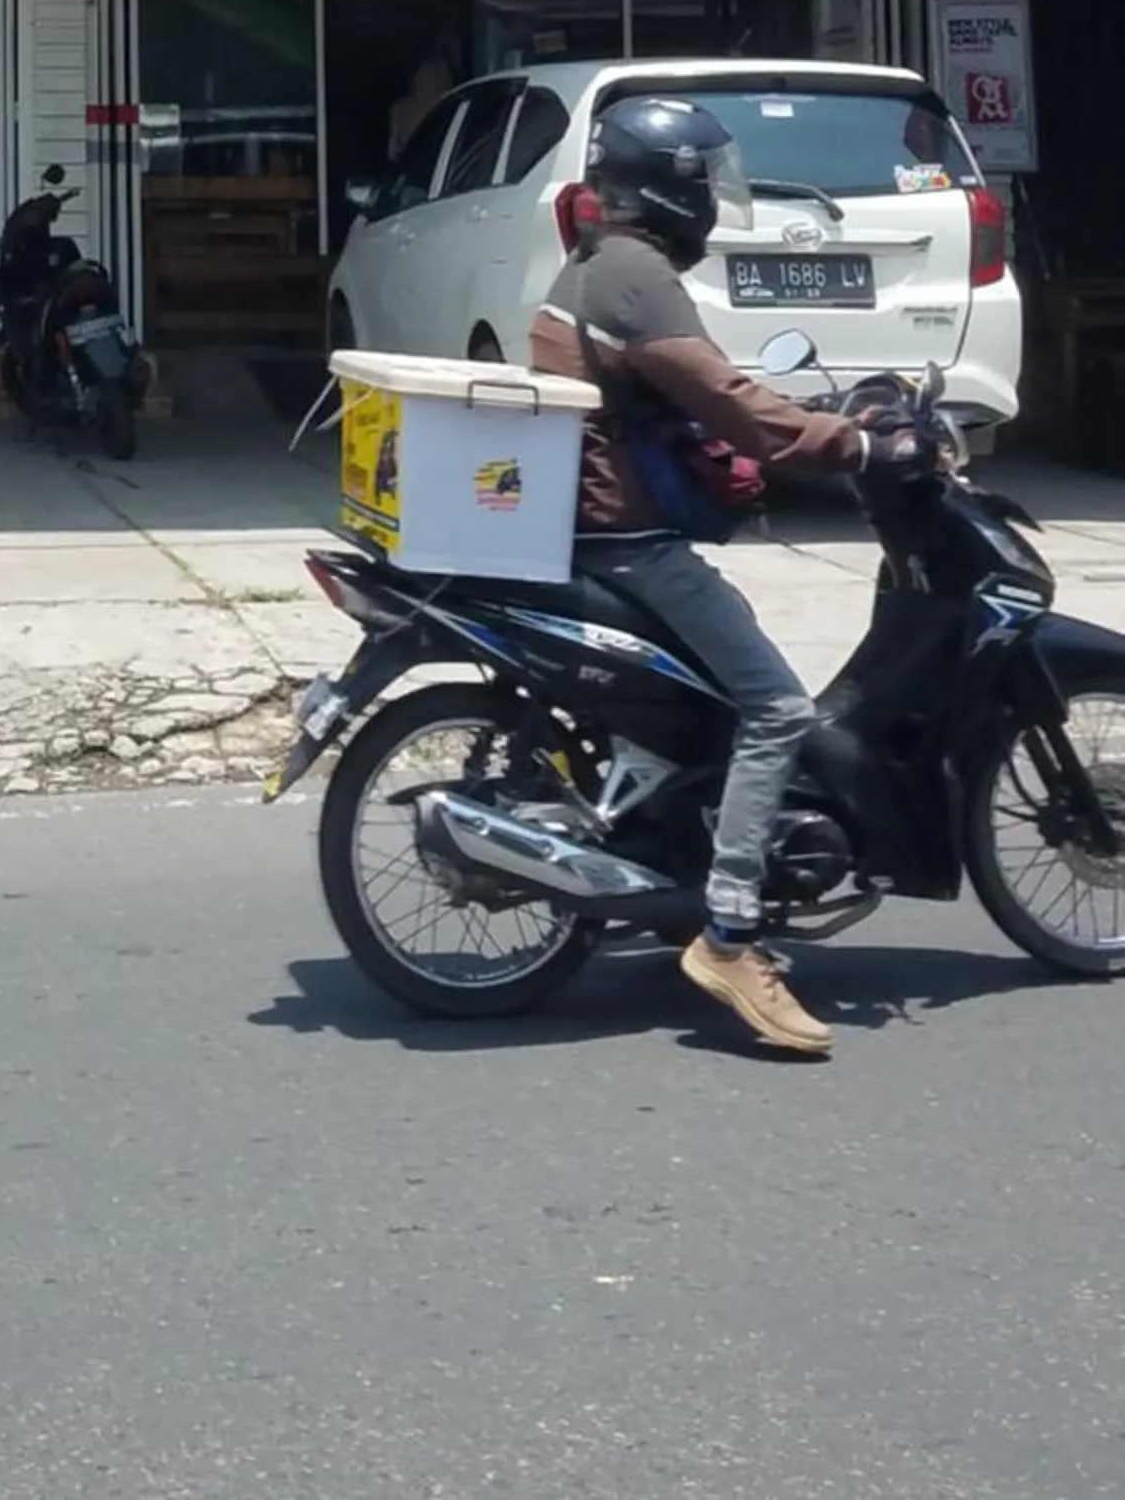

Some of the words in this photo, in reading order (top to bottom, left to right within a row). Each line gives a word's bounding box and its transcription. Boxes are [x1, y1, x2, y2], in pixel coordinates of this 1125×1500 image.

[735, 261, 763, 286] BA
[779, 262, 826, 288] 1686
[840, 262, 866, 288] LV
